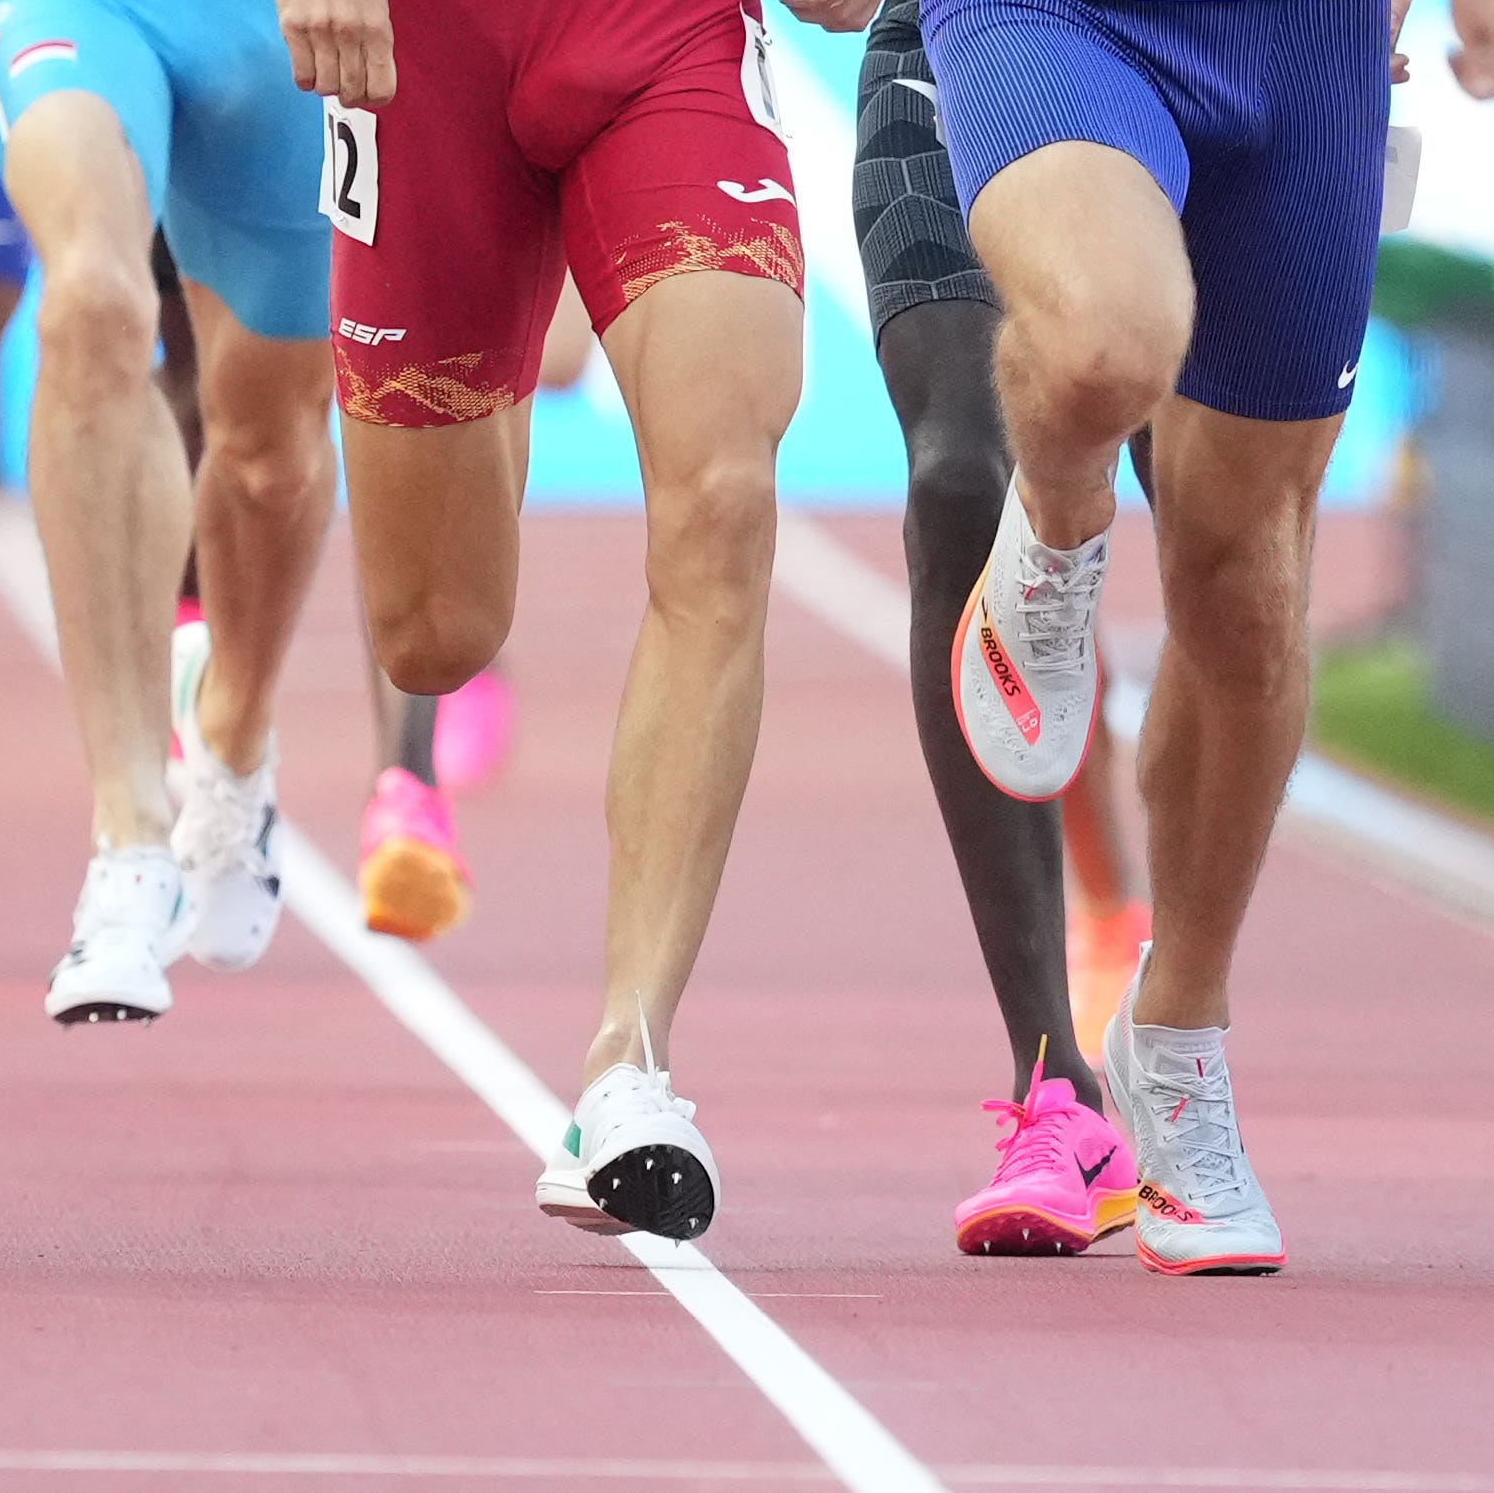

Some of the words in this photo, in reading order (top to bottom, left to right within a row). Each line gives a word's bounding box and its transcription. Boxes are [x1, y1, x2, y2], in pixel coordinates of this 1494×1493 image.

[328, 113, 361, 219] 12
[338, 318, 406, 346] ESP
[981, 627, 1021, 697] BROOKS
